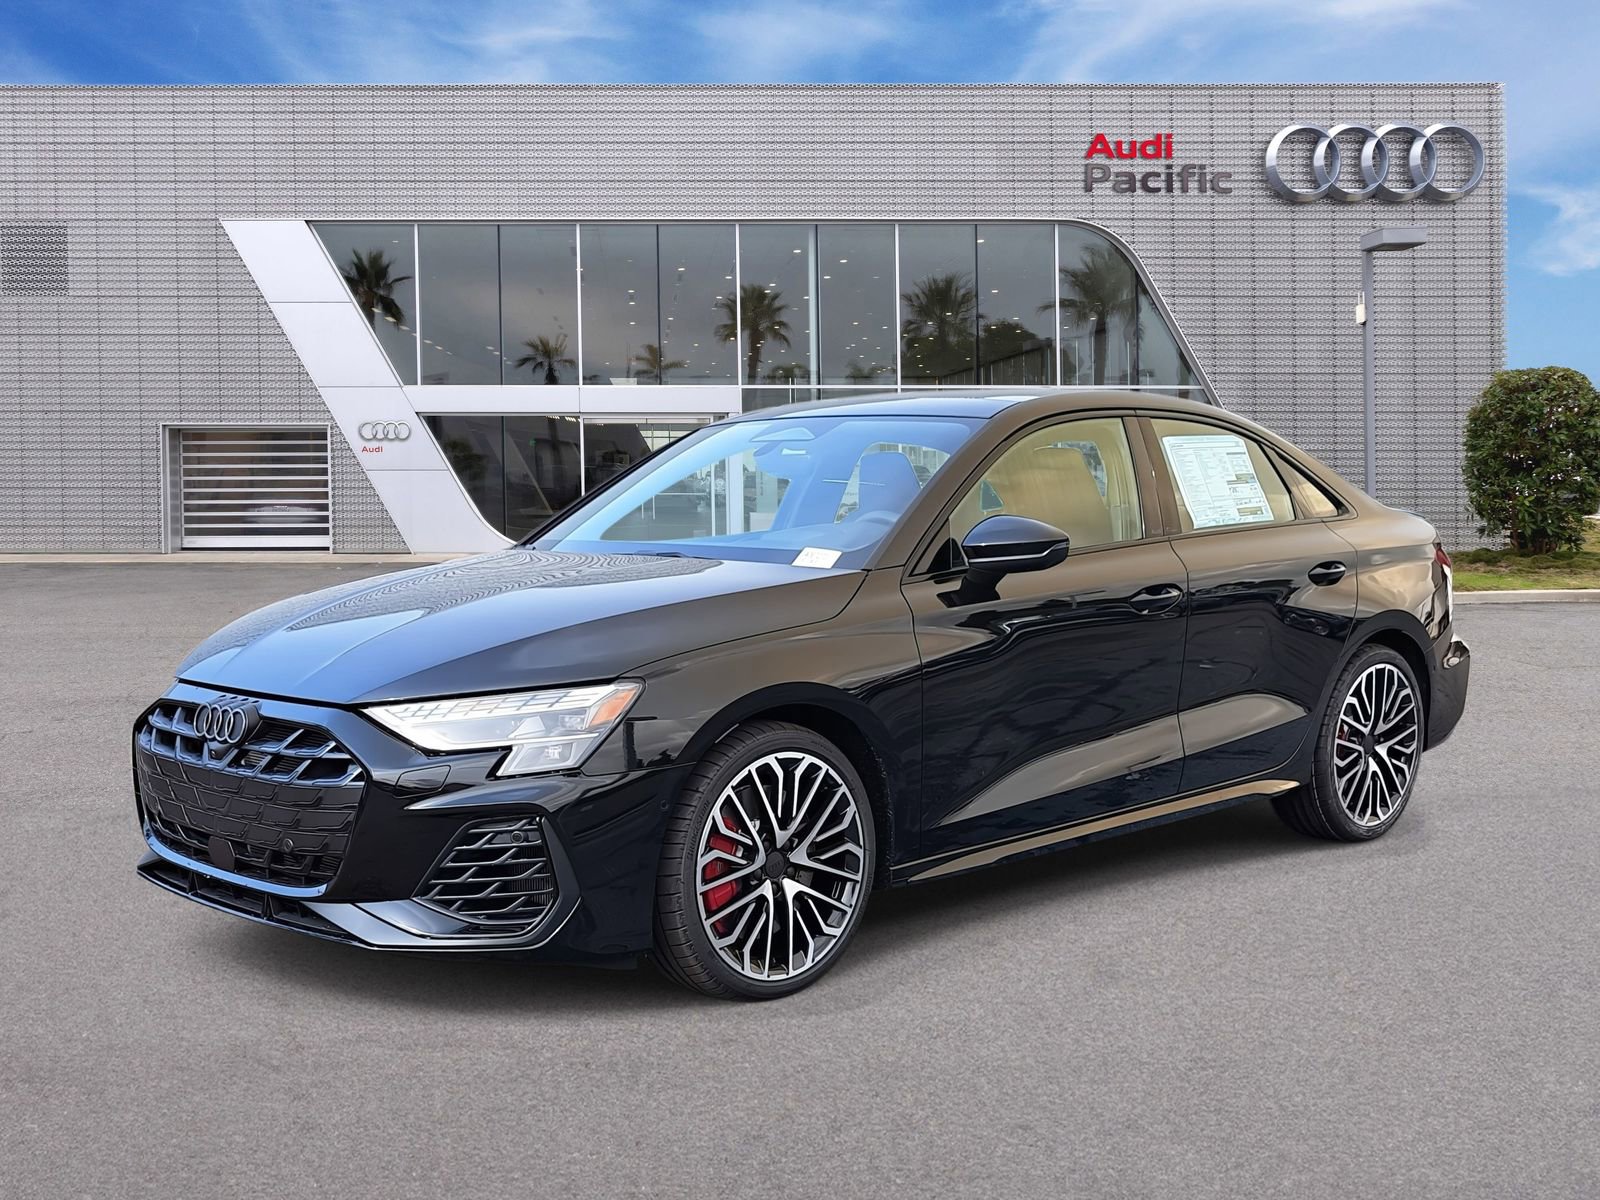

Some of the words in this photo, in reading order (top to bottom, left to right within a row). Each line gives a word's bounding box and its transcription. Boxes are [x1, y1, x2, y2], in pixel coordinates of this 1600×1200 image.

[1085, 132, 1173, 160] Audi
[1084, 163, 1233, 194] Pacific
[361, 445, 383, 453] Audi
